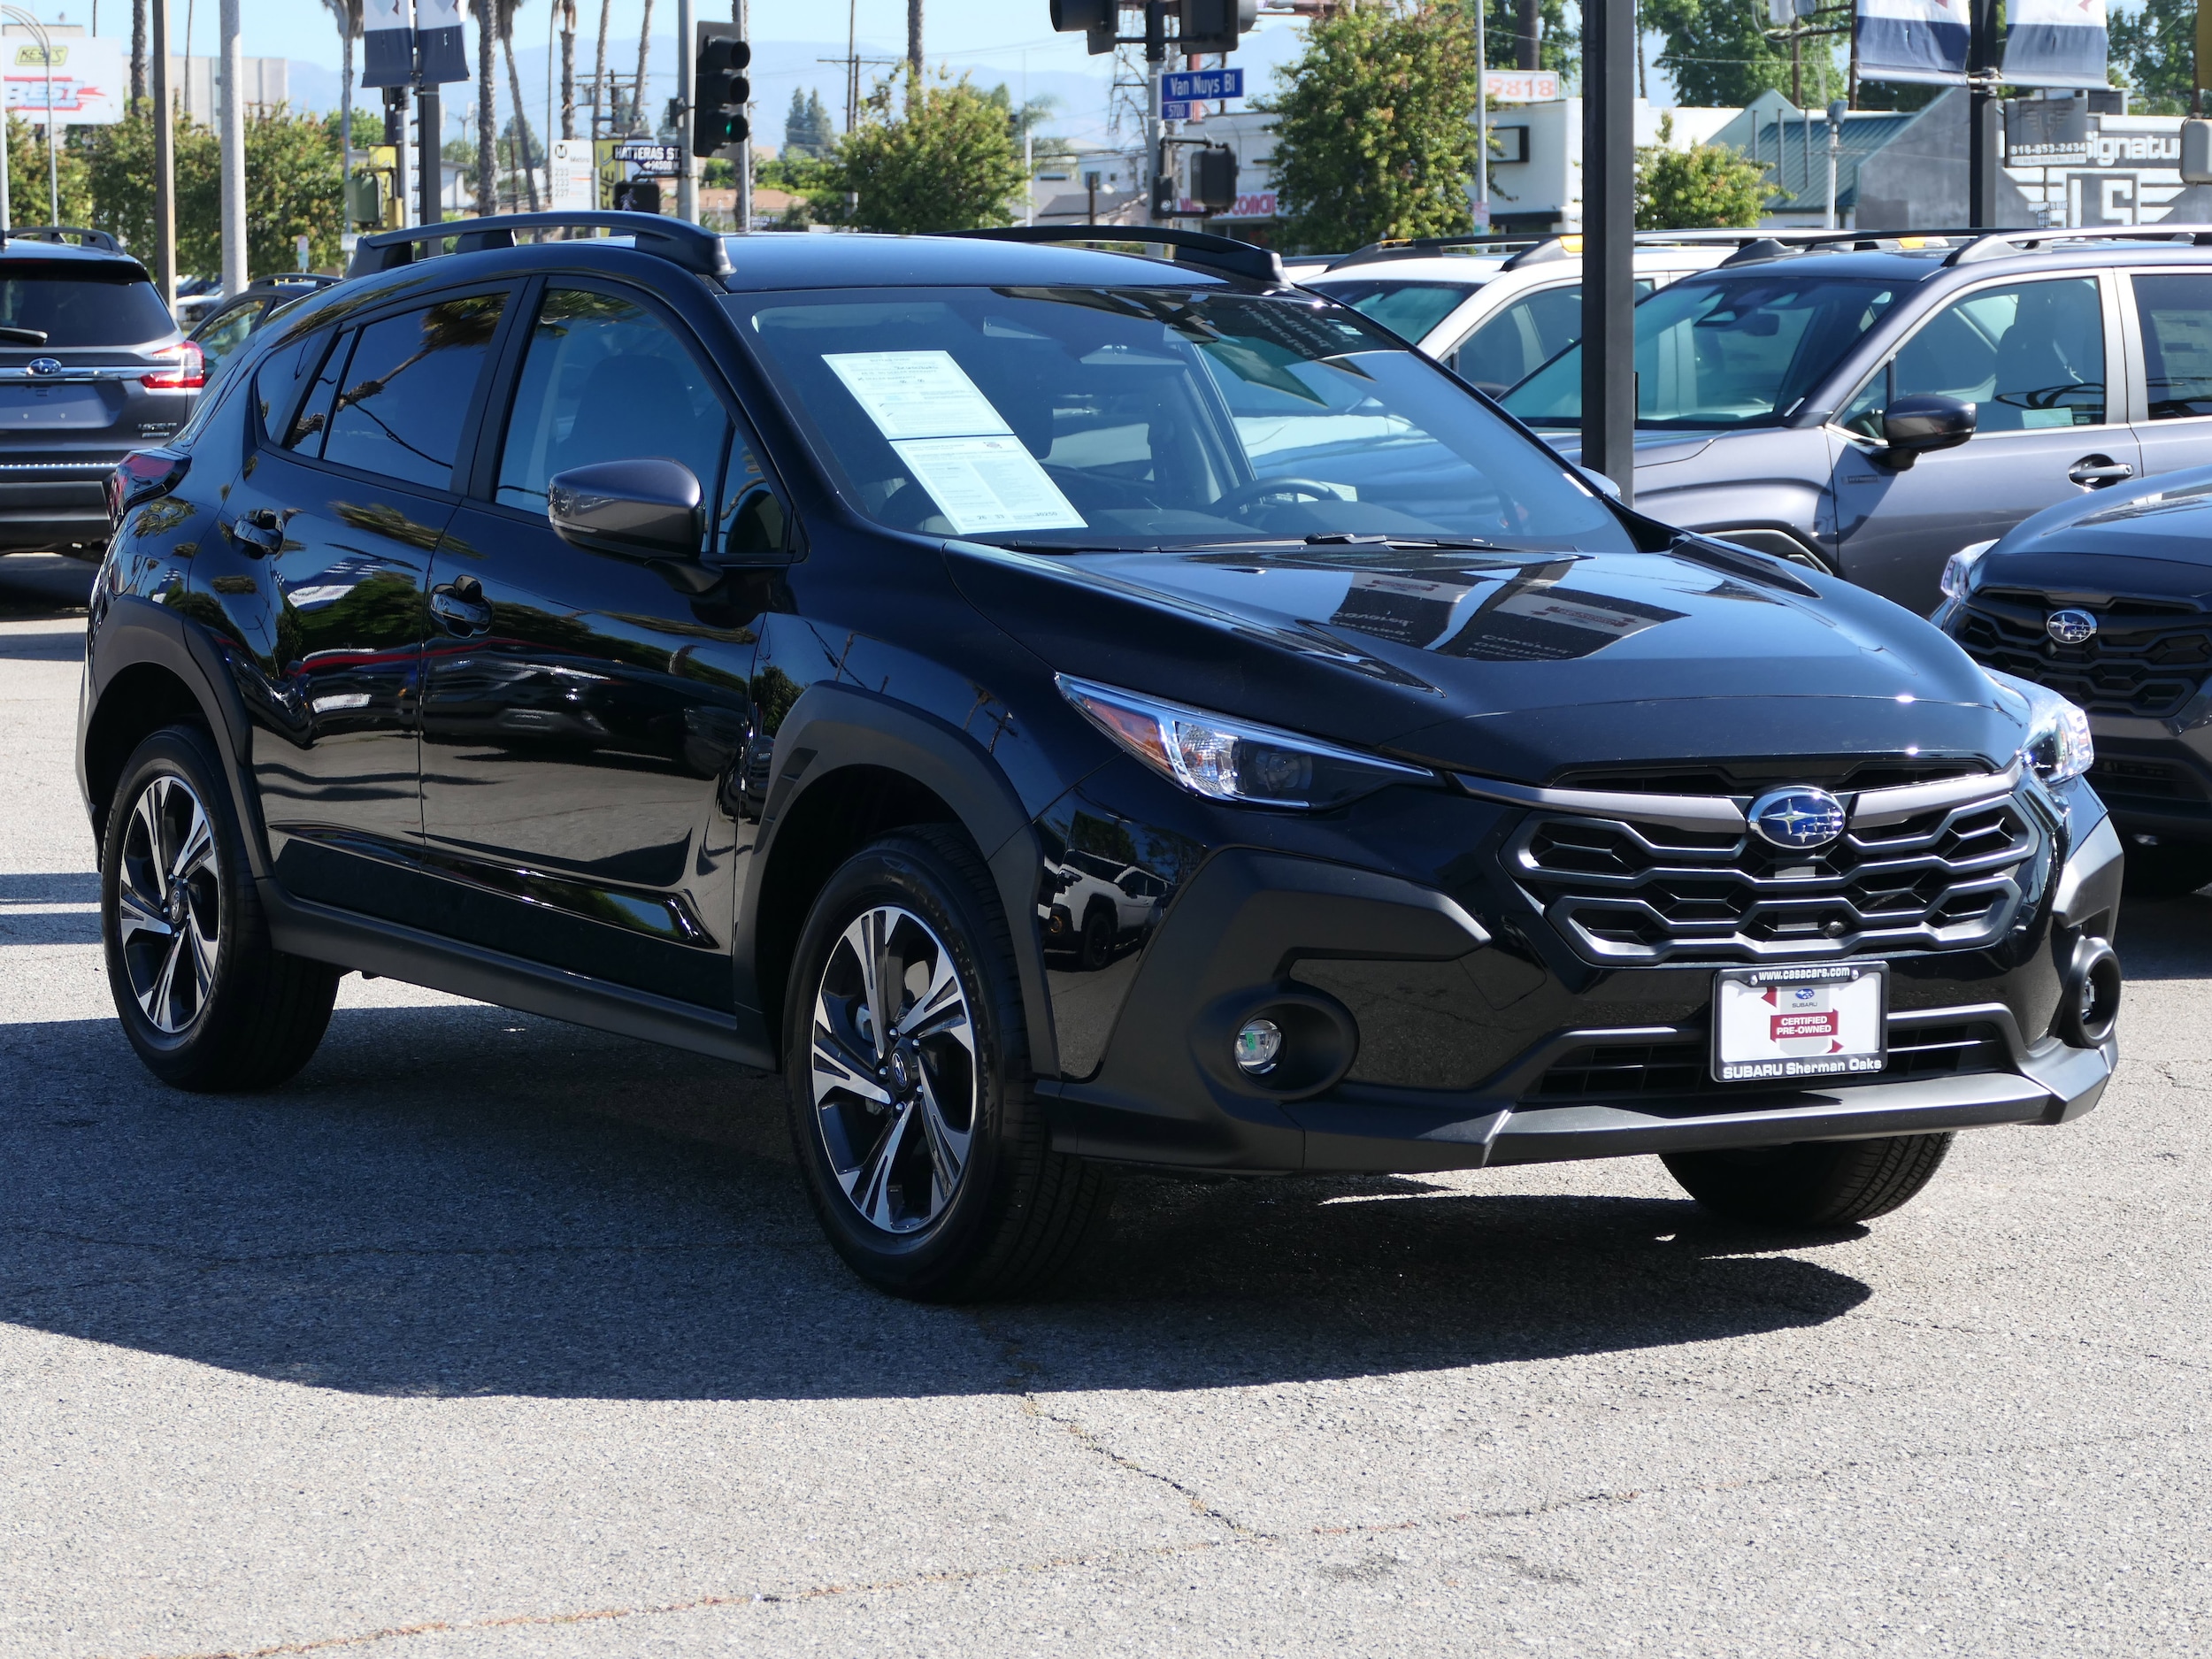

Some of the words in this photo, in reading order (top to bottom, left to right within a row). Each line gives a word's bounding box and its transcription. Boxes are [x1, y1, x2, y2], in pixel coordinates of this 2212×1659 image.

[1171, 77, 1189, 96] Van
[1194, 74, 1220, 98] Nuys
[1225, 73, 1235, 92] Bl
[1487, 78, 1555, 97] 5818
[1168, 104, 1185, 118] 5700
[614, 146, 664, 161] HATTERAS
[1758, 966, 1850, 981] www.casacars.com
[1781, 1016, 1828, 1026] CERTIFIED
[1776, 1024, 1832, 1035] PRE-OWNED
[1723, 1063, 1783, 1079] SUBARU
[1786, 1060, 1846, 1076] Sherman
[1849, 1057, 1883, 1071] Oaks
